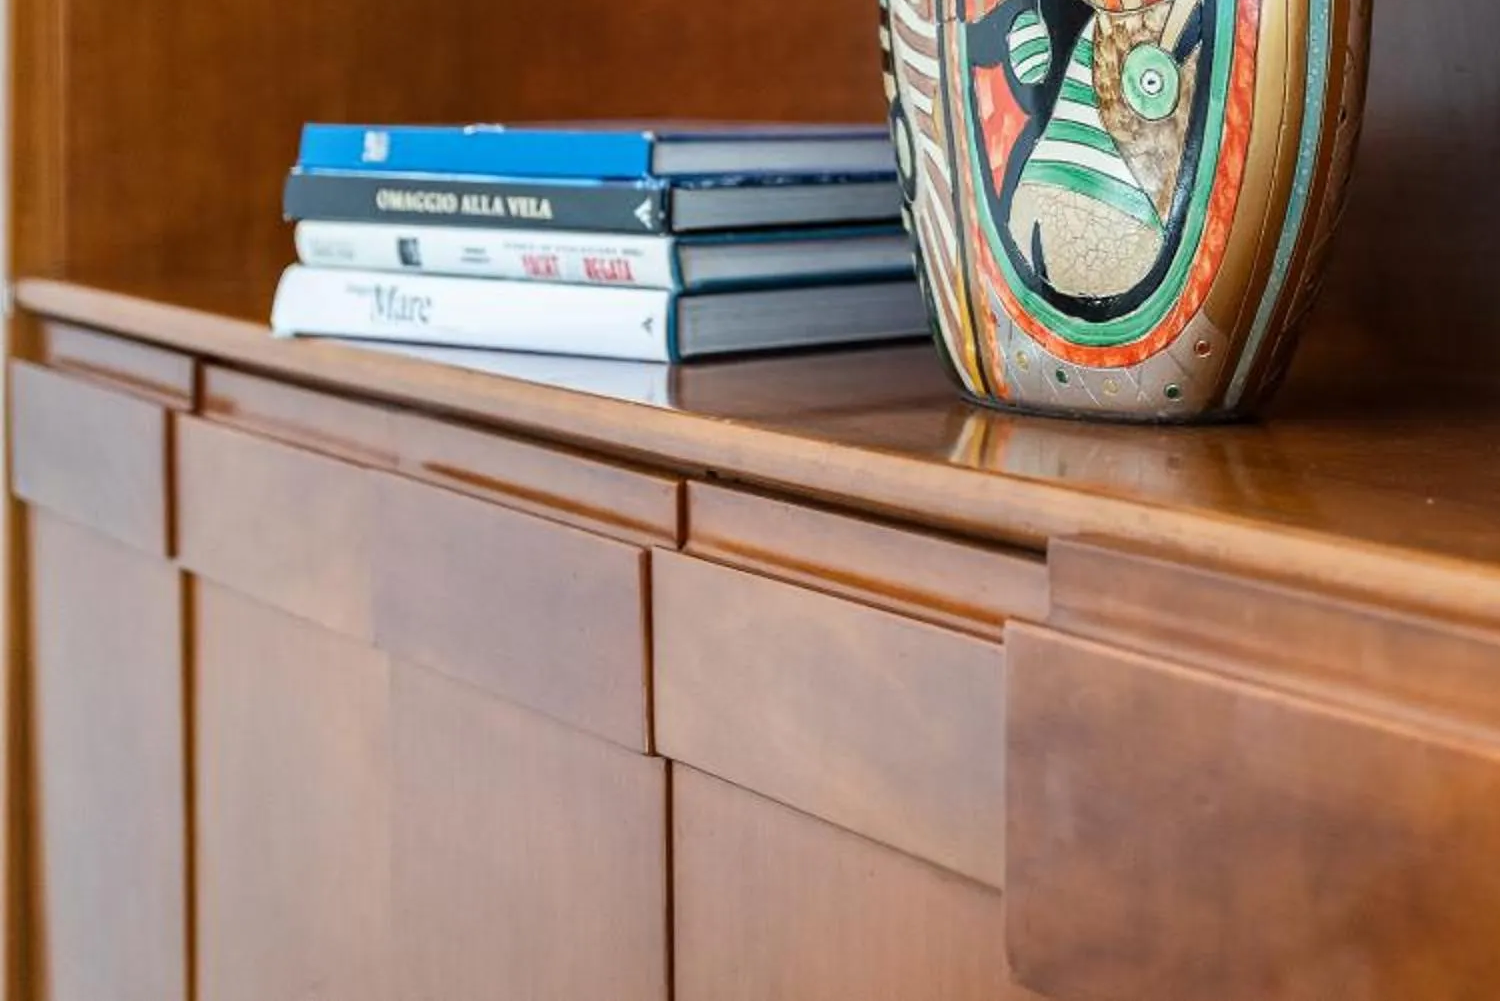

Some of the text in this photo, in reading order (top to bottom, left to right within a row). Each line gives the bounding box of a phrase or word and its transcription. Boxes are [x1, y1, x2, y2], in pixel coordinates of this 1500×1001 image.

[376, 188, 553, 220] OMAGGIO ALLA VELA
